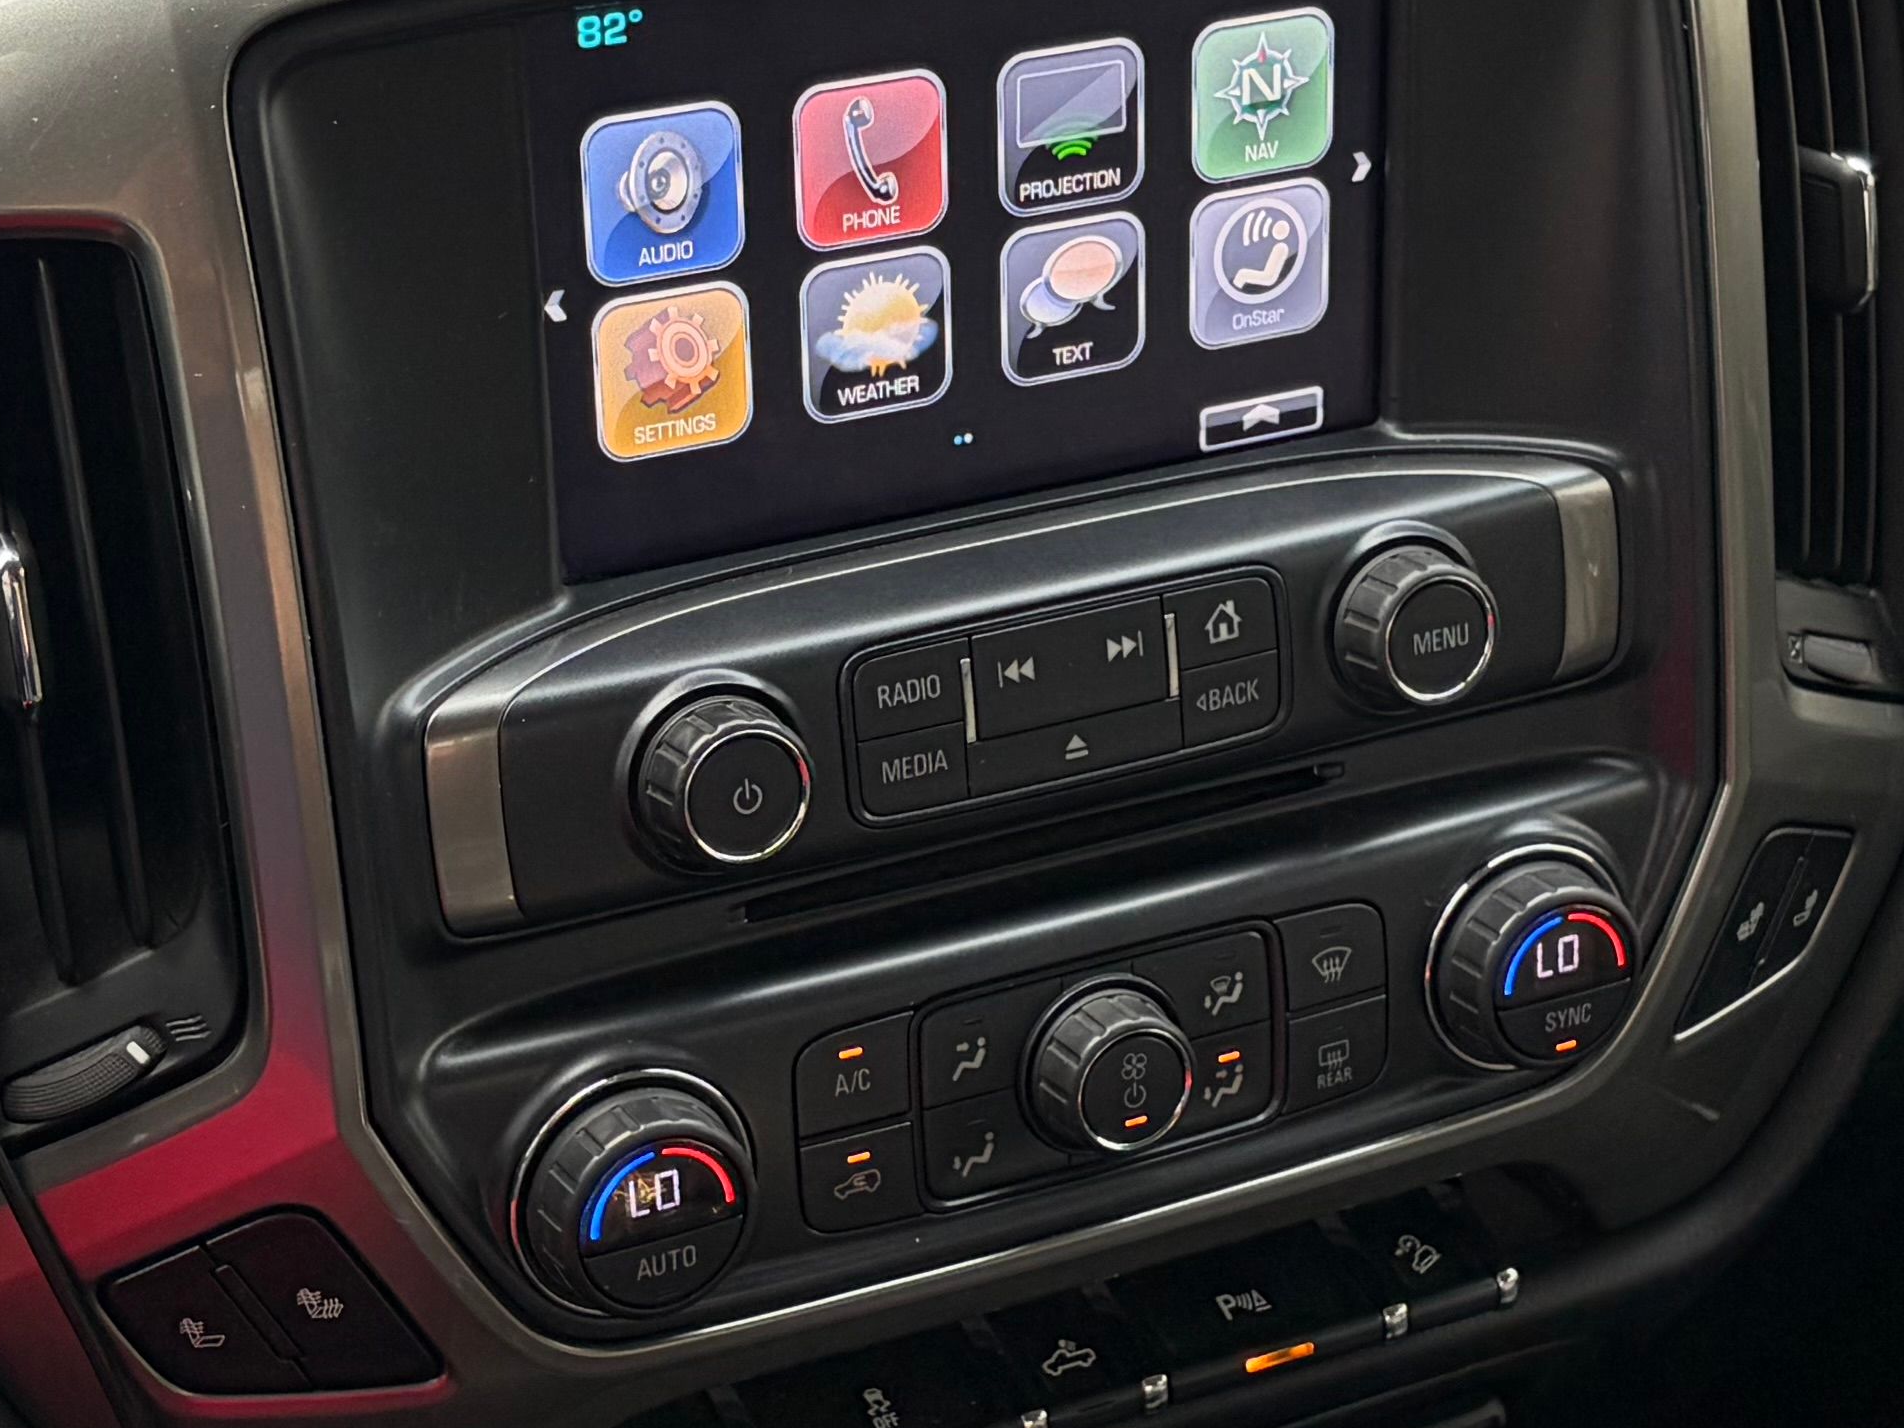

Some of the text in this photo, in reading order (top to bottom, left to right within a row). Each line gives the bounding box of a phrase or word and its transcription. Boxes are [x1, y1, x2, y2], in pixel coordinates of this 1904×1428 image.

[1244, 141, 1279, 163] NAV
[1019, 168, 1122, 202] PROJECTION
[842, 205, 901, 233] PHONE
[638, 240, 694, 267] AUDIO
[1232, 308, 1285, 330] OnStar
[1052, 342, 1094, 366] TEXT
[837, 375, 920, 406] WEATHER
[634, 412, 717, 445] SETTINGS
[1413, 624, 1469, 655] MENU
[877, 675, 942, 712] RADIO
[1207, 676, 1260, 711] BACK
[881, 749, 949, 784] MEDIA
[1545, 1002, 1592, 1032] SYNC
[834, 1067, 872, 1097] A/C
[1317, 1067, 1353, 1090] REAR
[636, 1244, 698, 1282] AUTO
